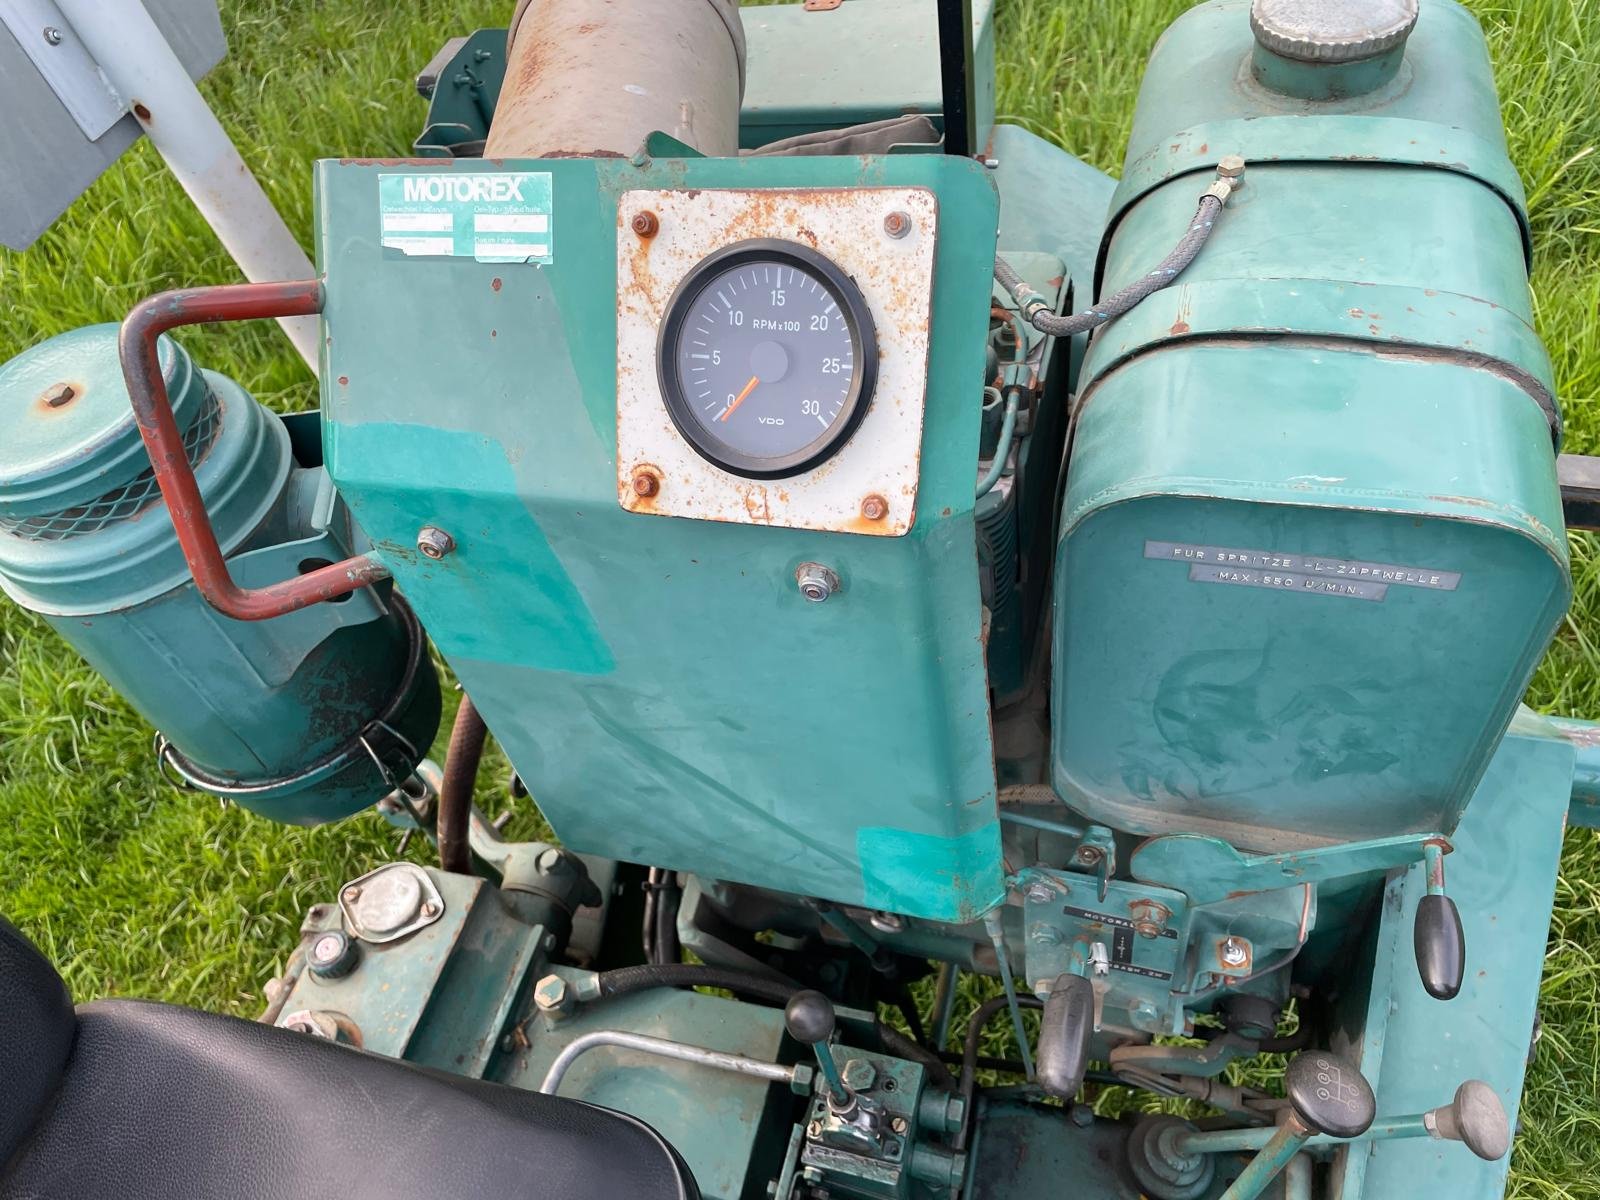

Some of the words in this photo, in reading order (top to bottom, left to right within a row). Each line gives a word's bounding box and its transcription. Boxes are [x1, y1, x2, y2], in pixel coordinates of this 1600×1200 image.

[404, 176, 524, 202] MOTOREX
[771, 290, 786, 306] 15
[728, 311, 743, 326] 10
[810, 315, 829, 331] 20
[712, 350, 721, 365] 5
[822, 358, 840, 374] 25
[727, 394, 735, 408] 0
[802, 400, 819, 416] 30
[758, 416, 785, 426] VDO
[1173, 548, 1205, 559] FUR
[1217, 553, 1291, 567] SPRITZE
[1305, 580, 1364, 594] U/MIN.
